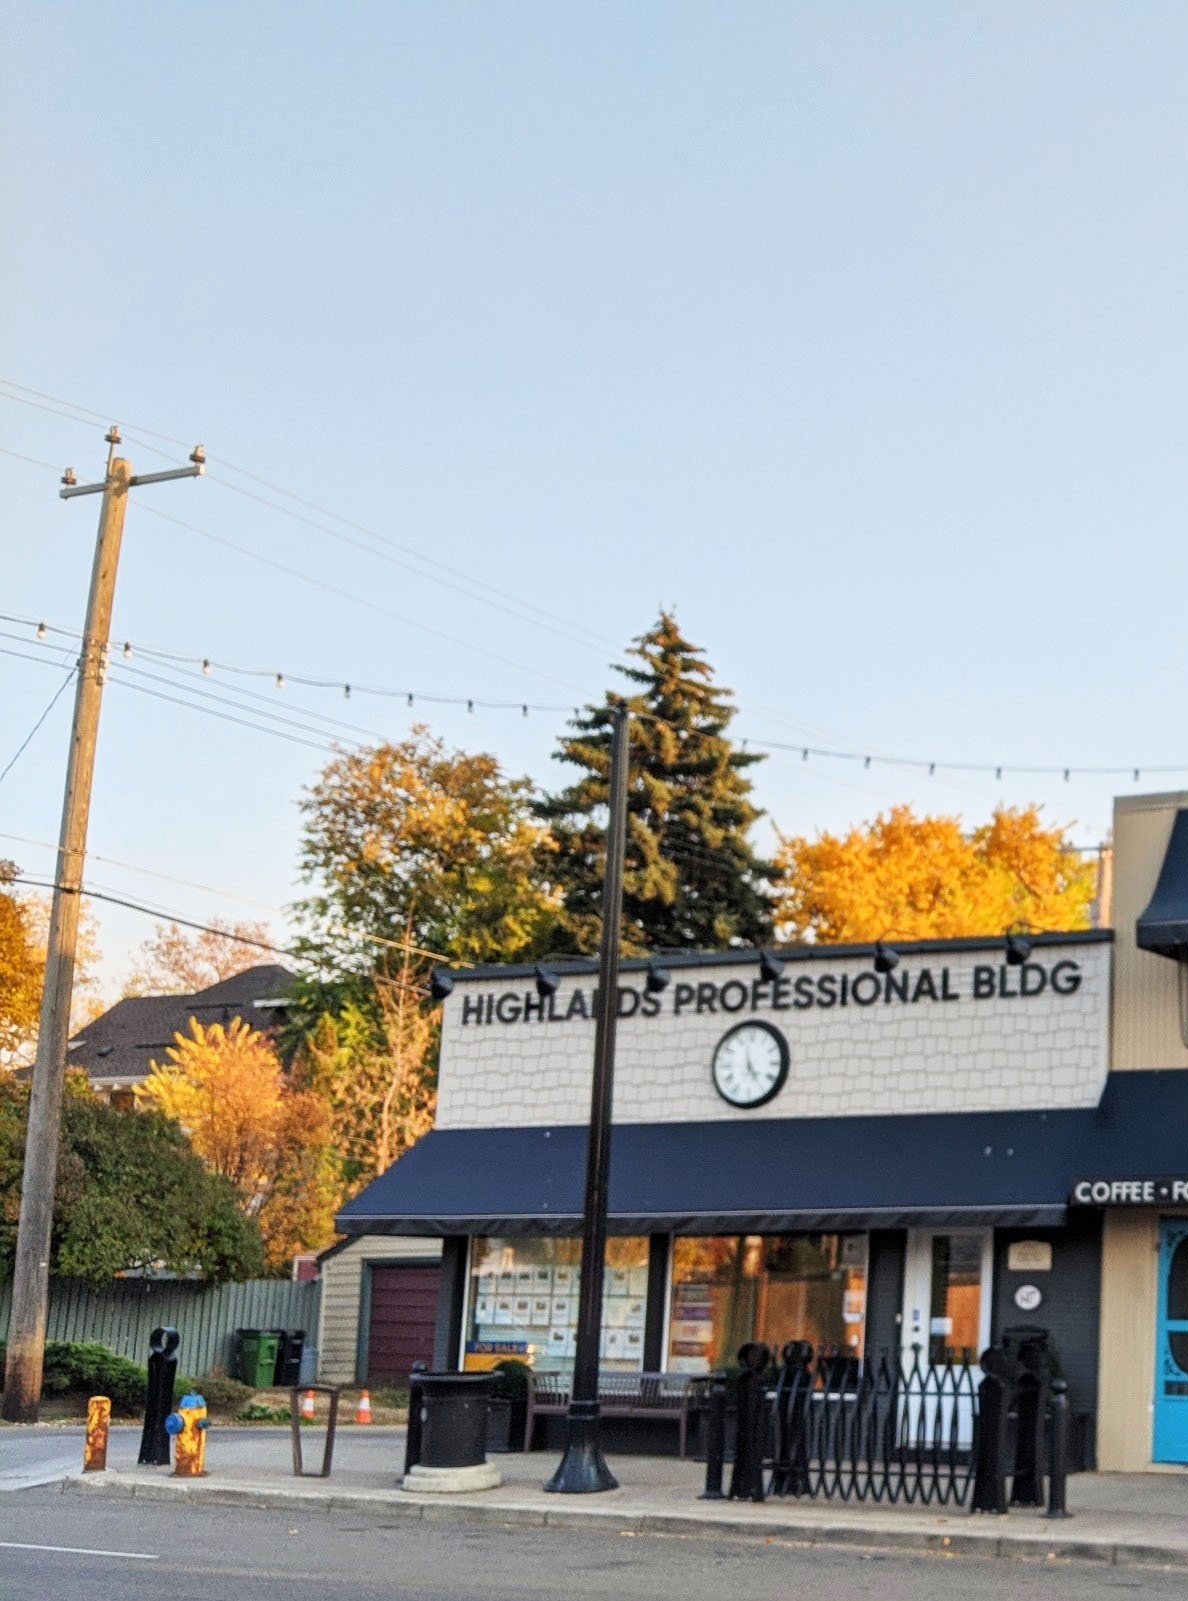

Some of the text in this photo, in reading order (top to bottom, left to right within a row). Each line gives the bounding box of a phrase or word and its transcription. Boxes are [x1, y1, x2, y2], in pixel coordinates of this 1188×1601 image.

[673, 967, 959, 1015] PROFESSIONAL
[973, 960, 1082, 1000] BLDG
[1074, 1180, 1156, 1202] COFFEE
